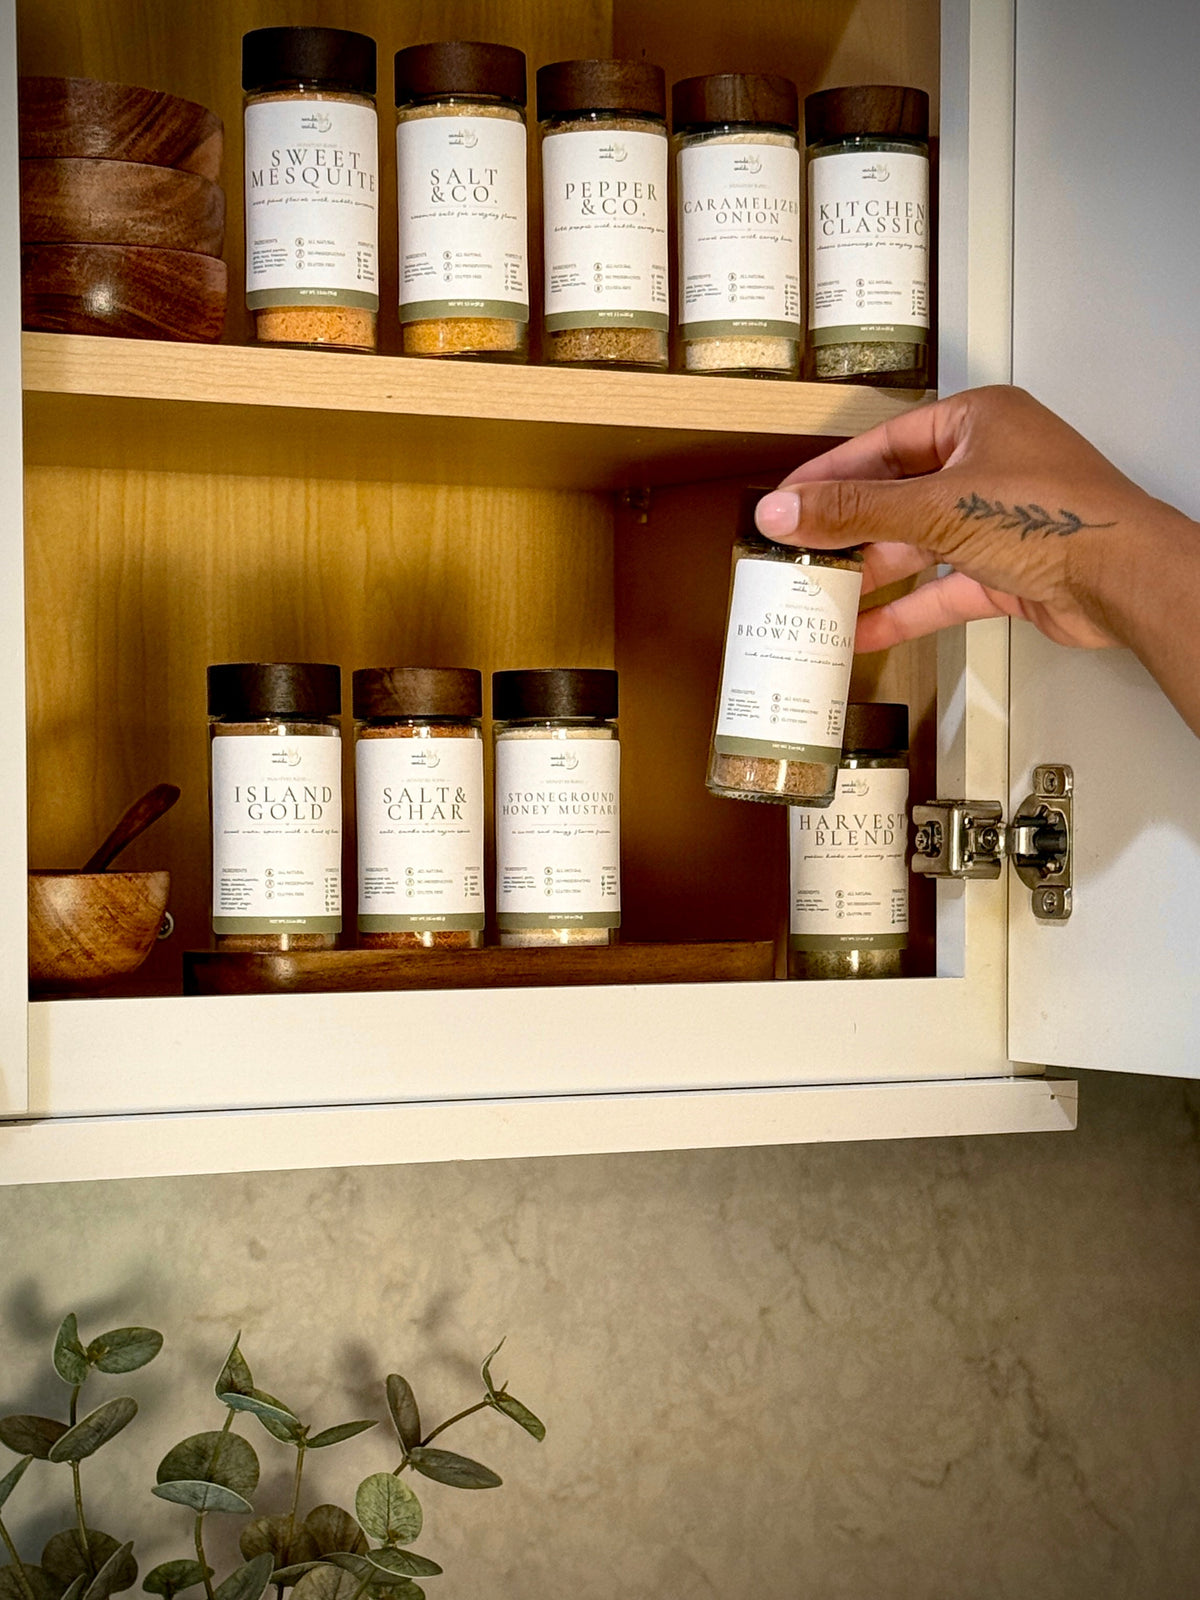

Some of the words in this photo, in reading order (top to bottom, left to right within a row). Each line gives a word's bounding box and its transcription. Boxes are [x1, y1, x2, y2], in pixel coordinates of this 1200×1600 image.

[271, 148, 361, 170] SWEET
[251, 166, 376, 192] MESQUITE
[430, 167, 498, 186] SALT
[431, 185, 498, 203] &CO.
[565, 181, 658, 201] PEPPER
[581, 198, 646, 217] &CO.
[820, 200, 925, 220] KITCHEN
[715, 211, 780, 225] ONION
[822, 217, 924, 236] CLASSIC
[763, 612, 839, 633] SMOKED
[736, 624, 800, 642] BROWN
[234, 785, 333, 804] ISLAND
[507, 792, 615, 803] STONEGROUND
[247, 803, 324, 821] GOLD
[387, 804, 464, 821] CHAR
[502, 805, 549, 816] HONEY
[799, 813, 906, 831] HARVEST
[815, 830, 895, 846] BLEND
